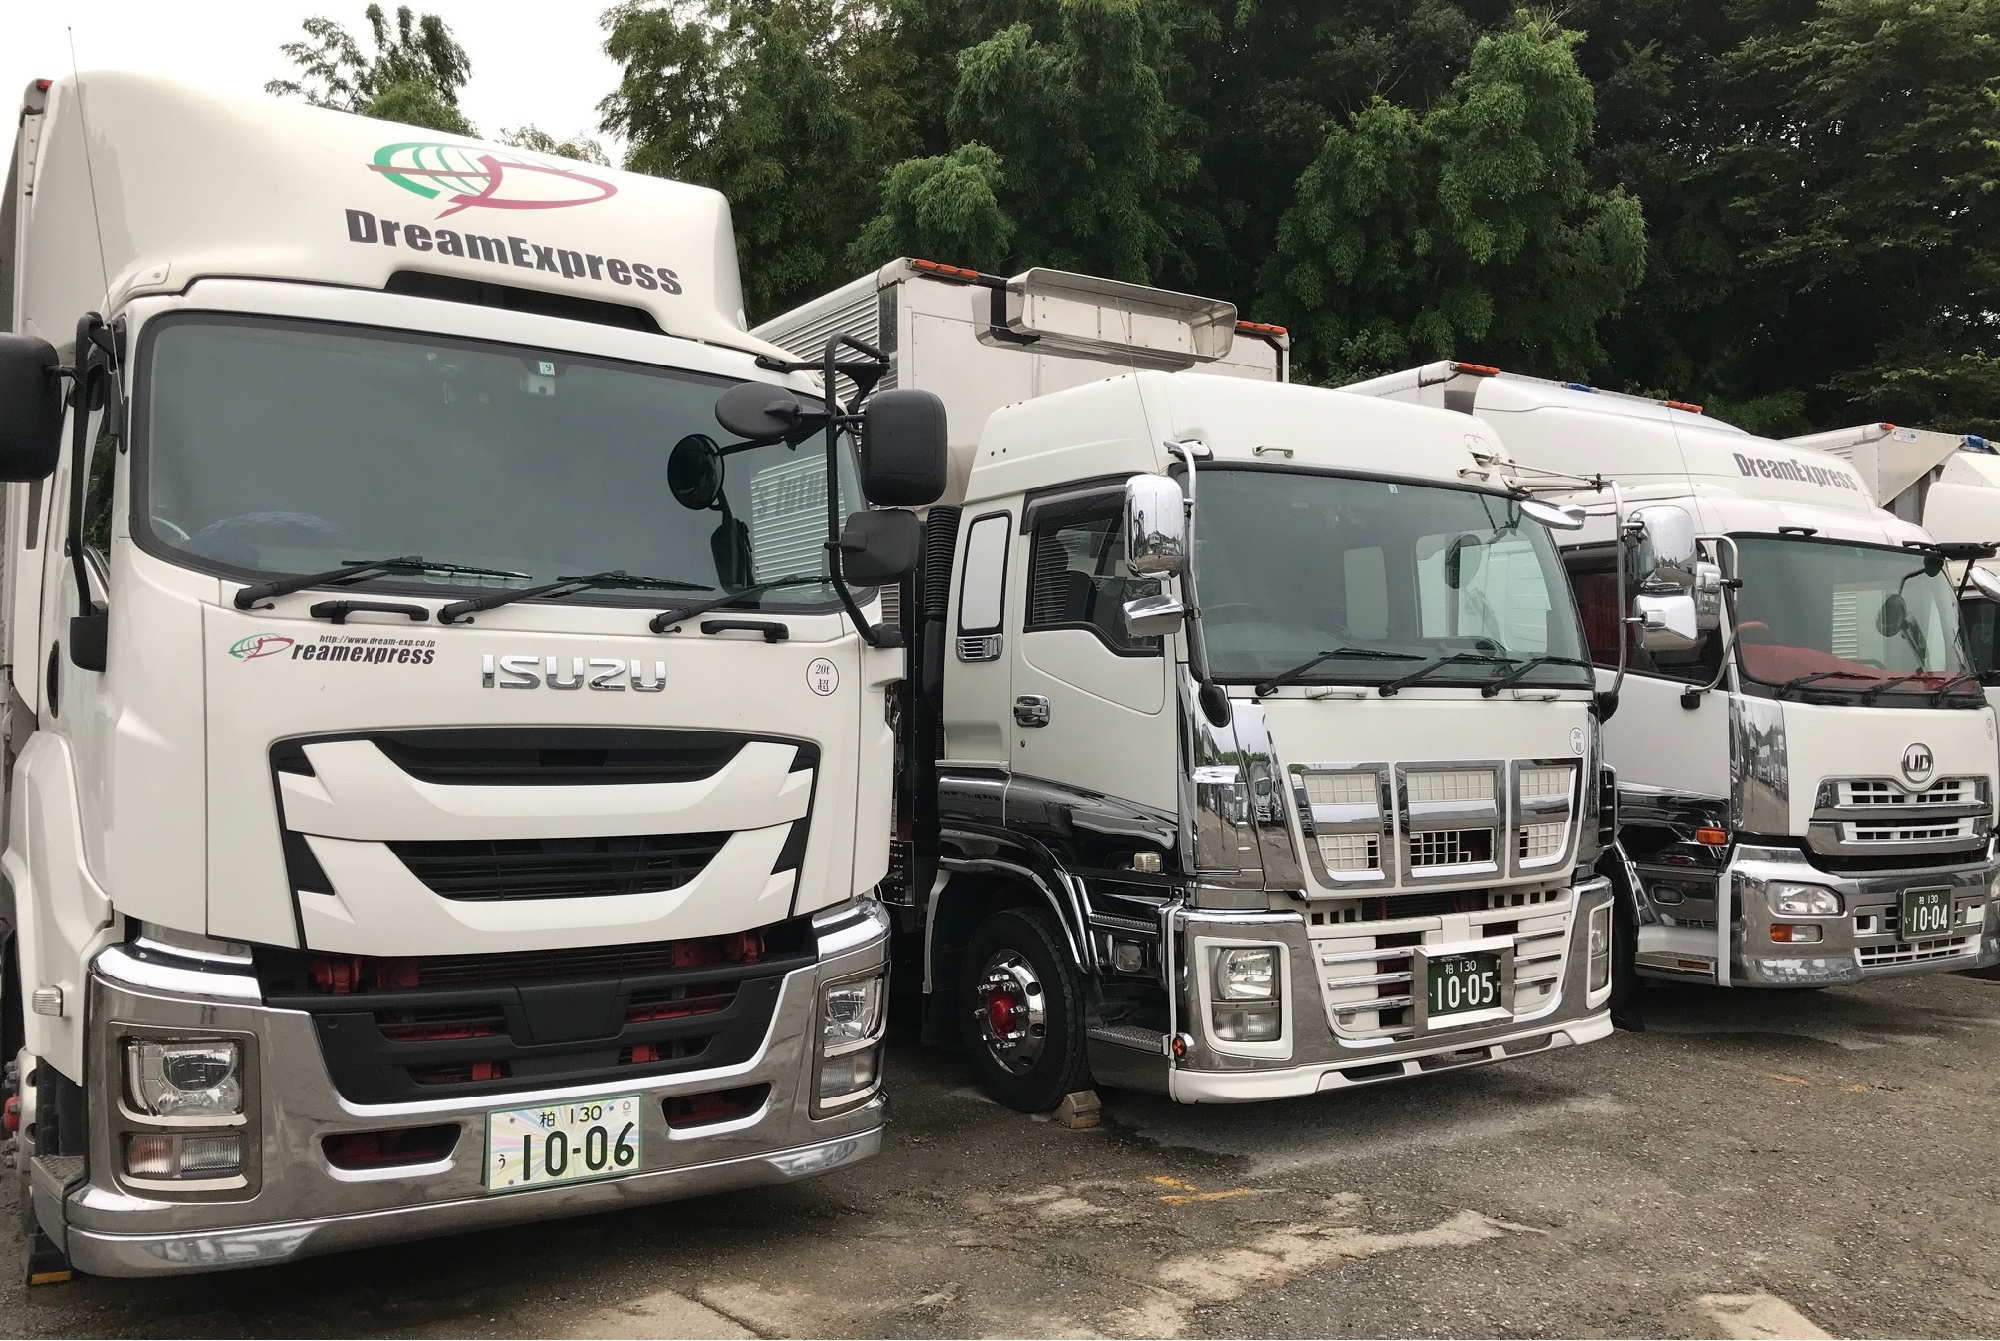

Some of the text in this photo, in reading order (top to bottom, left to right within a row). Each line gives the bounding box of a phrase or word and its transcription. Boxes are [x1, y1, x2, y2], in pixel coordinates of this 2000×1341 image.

[345, 208, 683, 296] DreamExpress
[1732, 452, 1859, 491] DreamExpress
[319, 634, 436, 648] http://www.dream-exp.co.jp
[482, 654, 667, 692] ISUZU
[815, 664, 830, 675] 20t
[1906, 754, 1931, 772] UD
[1927, 894, 1939, 904] 130
[1460, 960, 1477, 973] 130
[1437, 971, 1494, 1011] 10-05
[540, 1105, 603, 1128] 柏 130
[523, 1121, 635, 1181] 10-06
[498, 1153, 506, 1170] う
